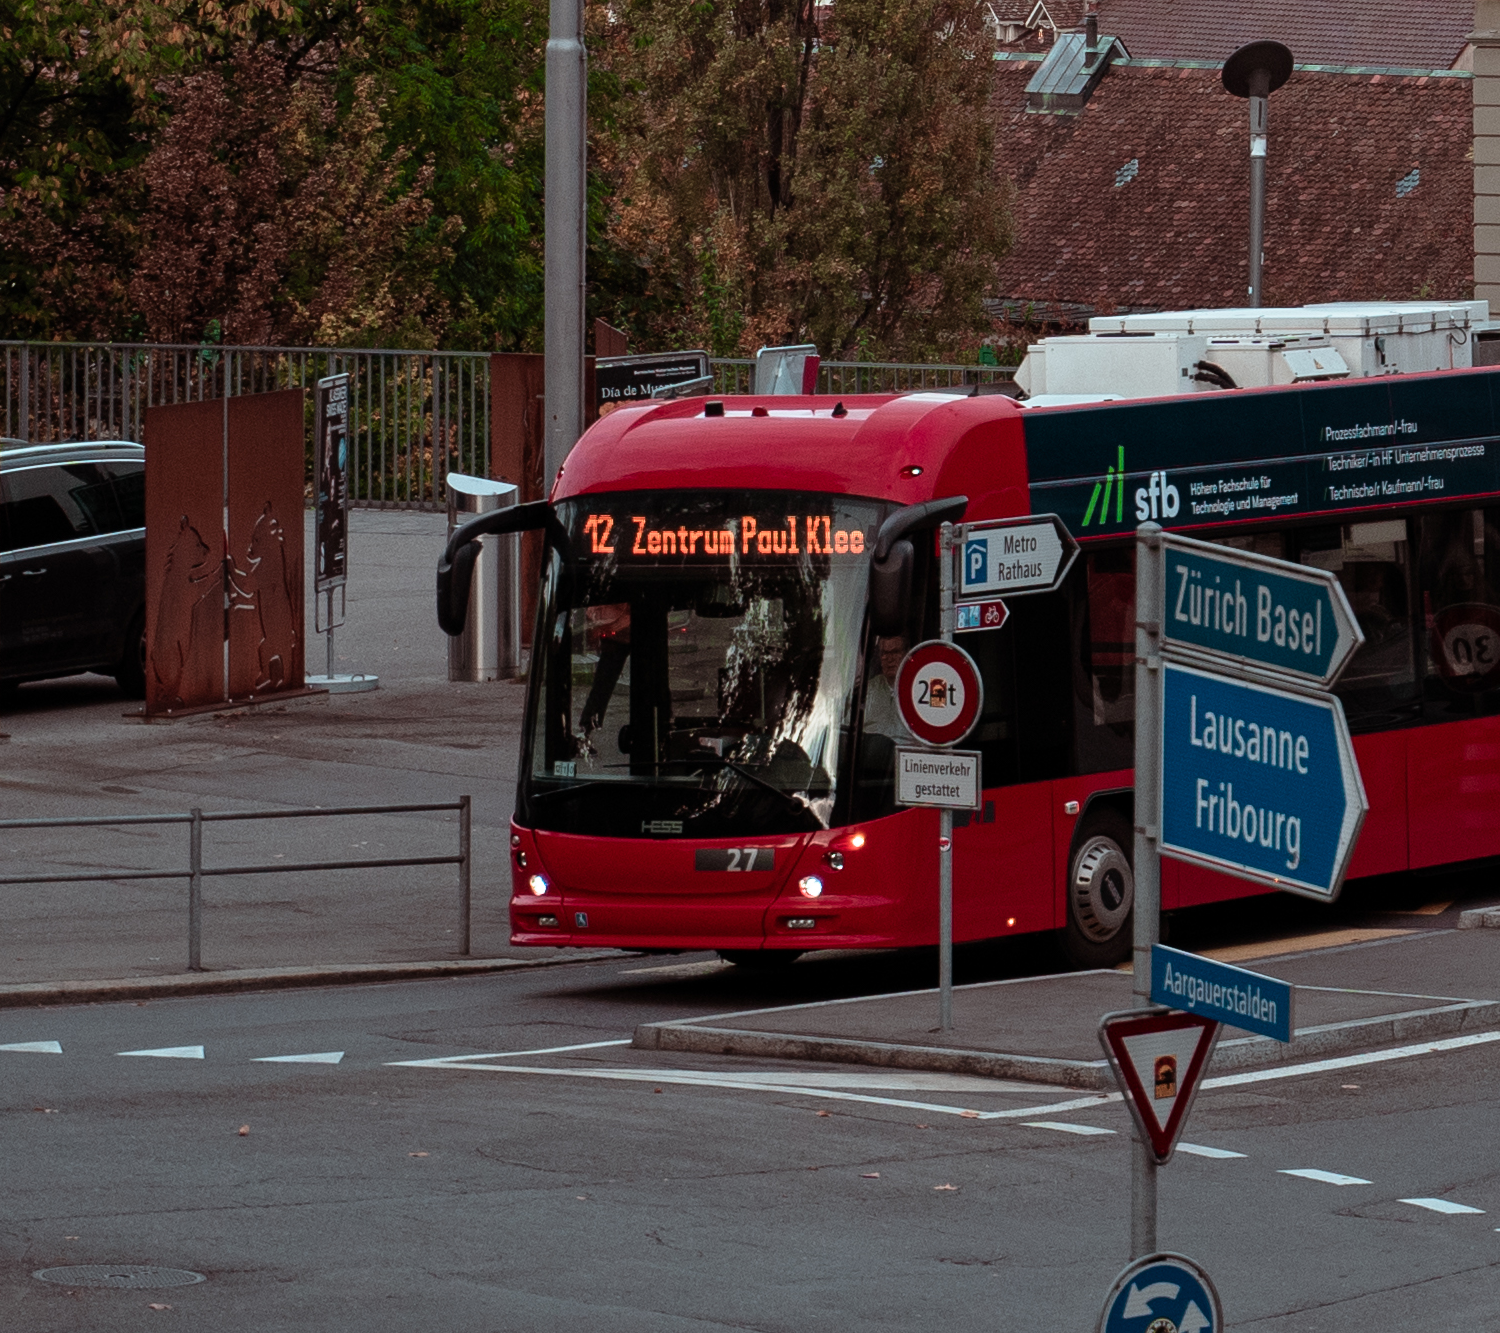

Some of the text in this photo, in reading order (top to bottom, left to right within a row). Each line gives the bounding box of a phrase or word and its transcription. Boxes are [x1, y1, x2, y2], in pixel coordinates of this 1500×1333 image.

[1135, 471, 1181, 521] sfb
[1190, 475, 1273, 497] Höhere Fachschule für
[1191, 492, 1299, 516] Technologie und Management
[583, 514, 865, 555] 12 Zentrum Paul Klee
[1004, 535, 1038, 556] Metro
[998, 560, 1043, 582] Rathaus
[1175, 564, 1324, 656] Zürich Basel
[917, 679, 957, 707] 2t
[1190, 694, 1309, 775] Lausanne
[905, 759, 971, 777] Linienverkehr
[914, 784, 960, 800] gestattet
[641, 820, 684, 834] HESS
[1195, 777, 1302, 870] Fribourg
[726, 848, 759, 872] 27
[1163, 961, 1278, 1025] Aargauerstalden
